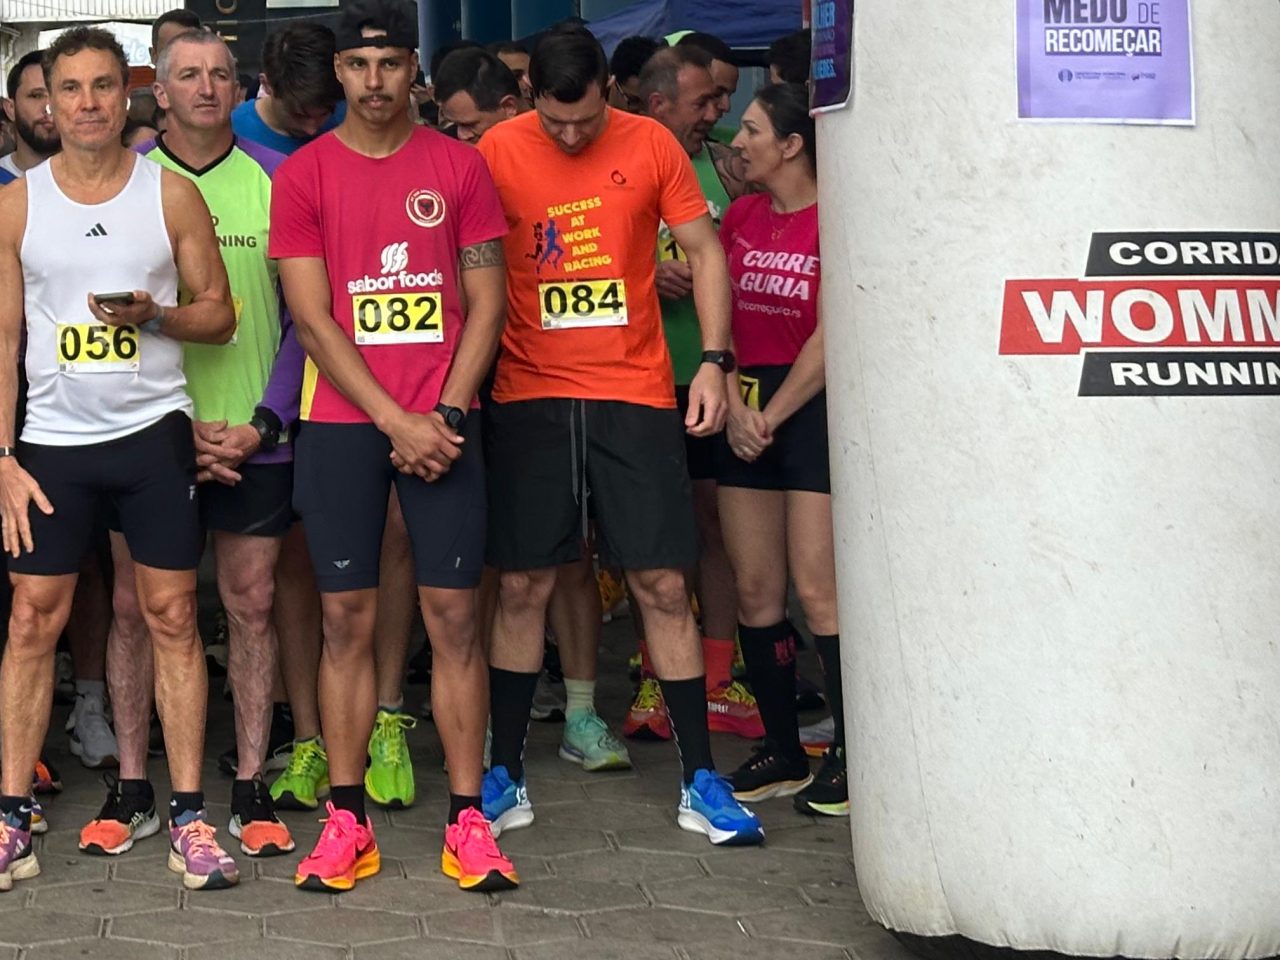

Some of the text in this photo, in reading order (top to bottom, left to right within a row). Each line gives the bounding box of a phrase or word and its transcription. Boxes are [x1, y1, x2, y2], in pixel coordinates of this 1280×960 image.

[1138, 2, 1160, 24] DE
[1045, 28, 1161, 56] RECOMEÇAR
[547, 196, 602, 217] SUCCESS
[570, 214, 585, 228] AT
[562, 226, 601, 244] WORK
[572, 242, 598, 257] AND
[1109, 241, 1280, 266] CORRID
[564, 255, 612, 272] RACING
[742, 250, 819, 276] CORRE
[740, 272, 809, 300] GURIA
[544, 282, 624, 318] 084
[358, 296, 439, 333] 082
[60, 325, 137, 360] 056
[1111, 362, 1280, 386] RUNNI
